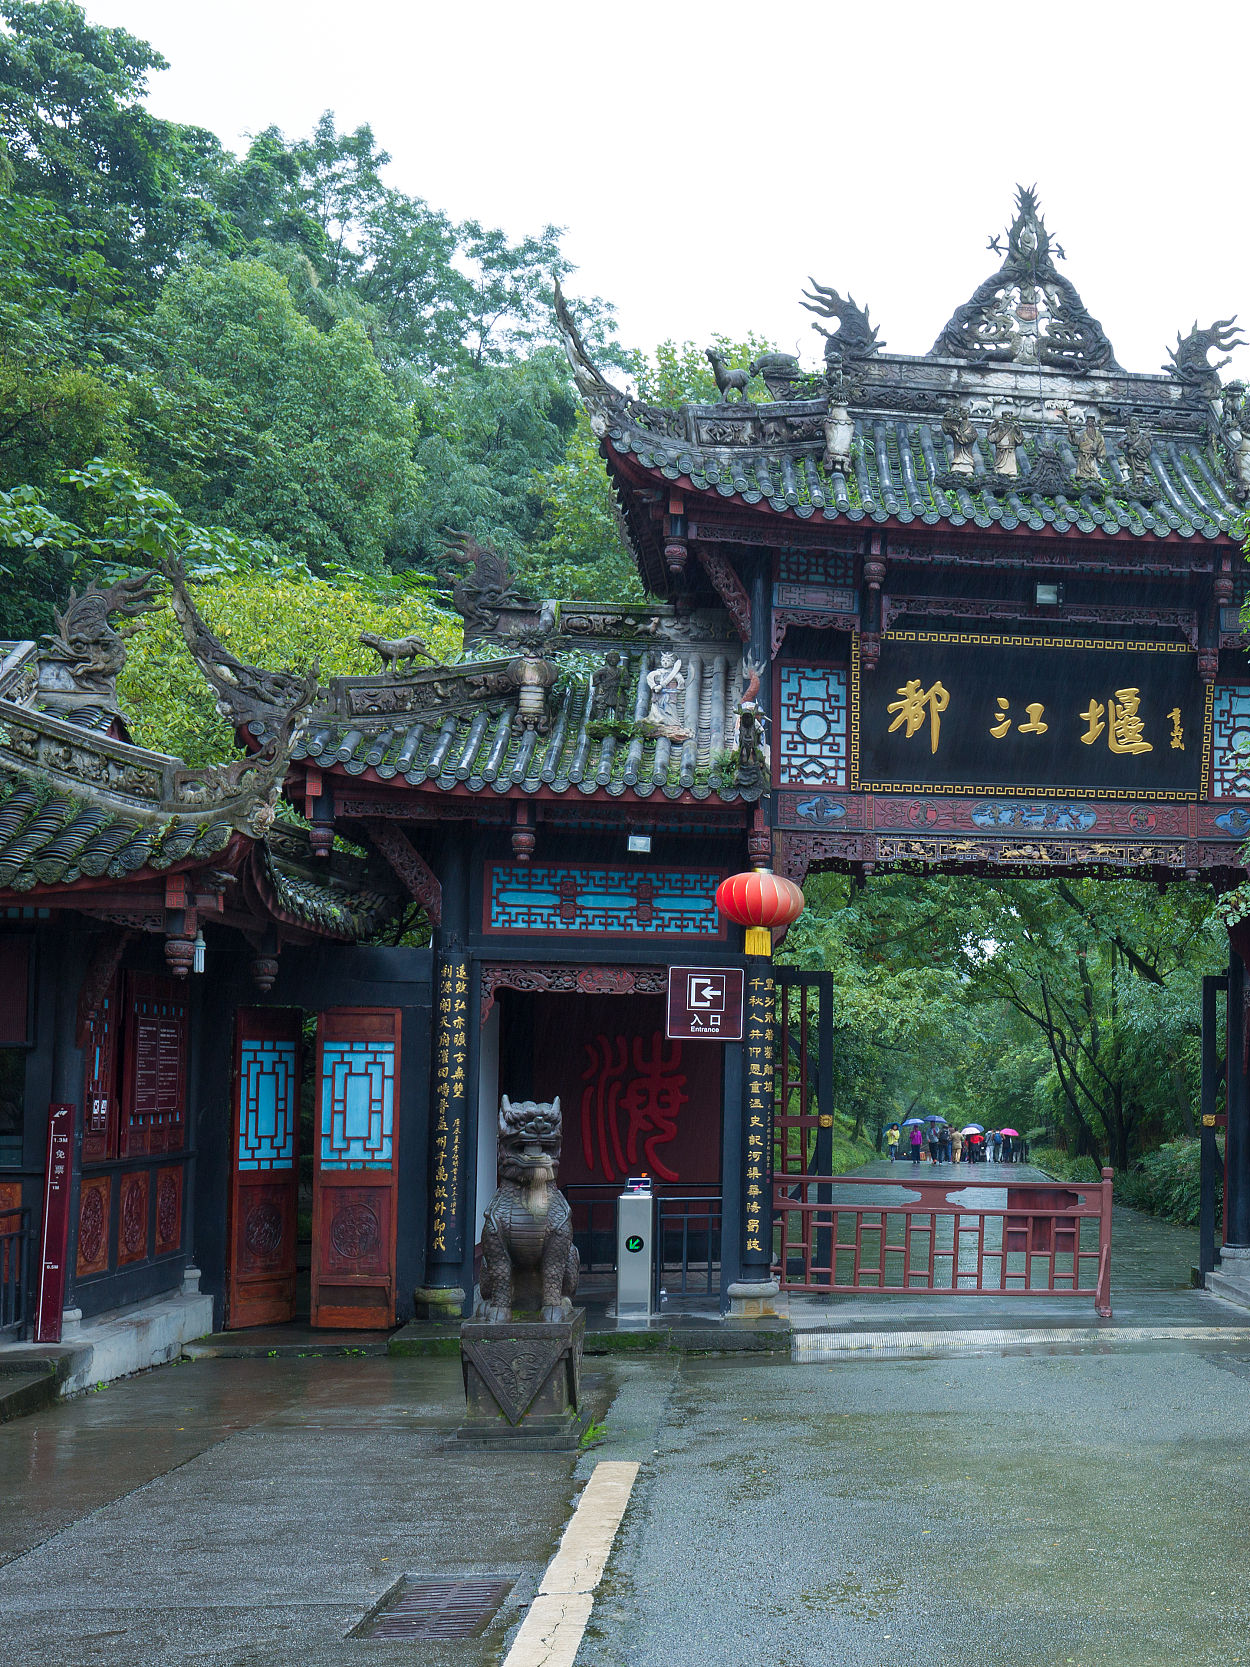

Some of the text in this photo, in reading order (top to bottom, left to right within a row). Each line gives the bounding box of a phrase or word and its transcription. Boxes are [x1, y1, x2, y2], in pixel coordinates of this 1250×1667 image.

[887, 679, 1153, 755] 都江堰
[690, 1013, 721, 1026] 入口
